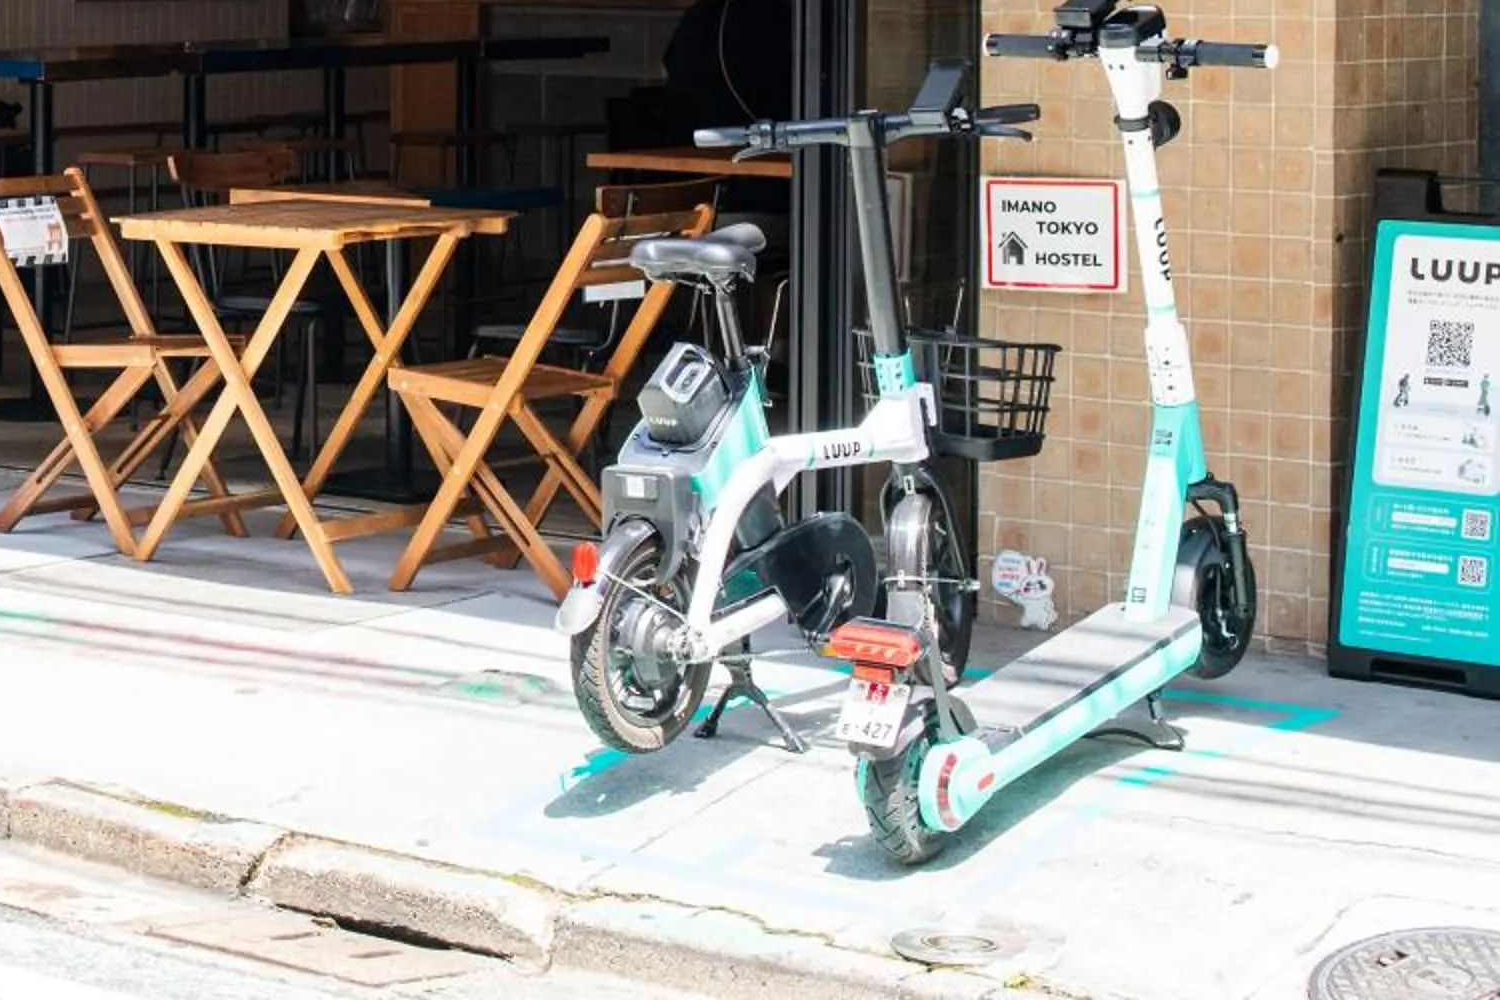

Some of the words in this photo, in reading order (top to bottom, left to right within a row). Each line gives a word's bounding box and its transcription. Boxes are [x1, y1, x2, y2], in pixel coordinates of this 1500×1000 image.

[1001, 199, 1057, 214] IMANO
[1035, 221, 1099, 236] TOKYO
[1035, 252, 1103, 267] HOSTEL
[1410, 257, 1500, 285] LUUP
[823, 441, 862, 460] LUUP
